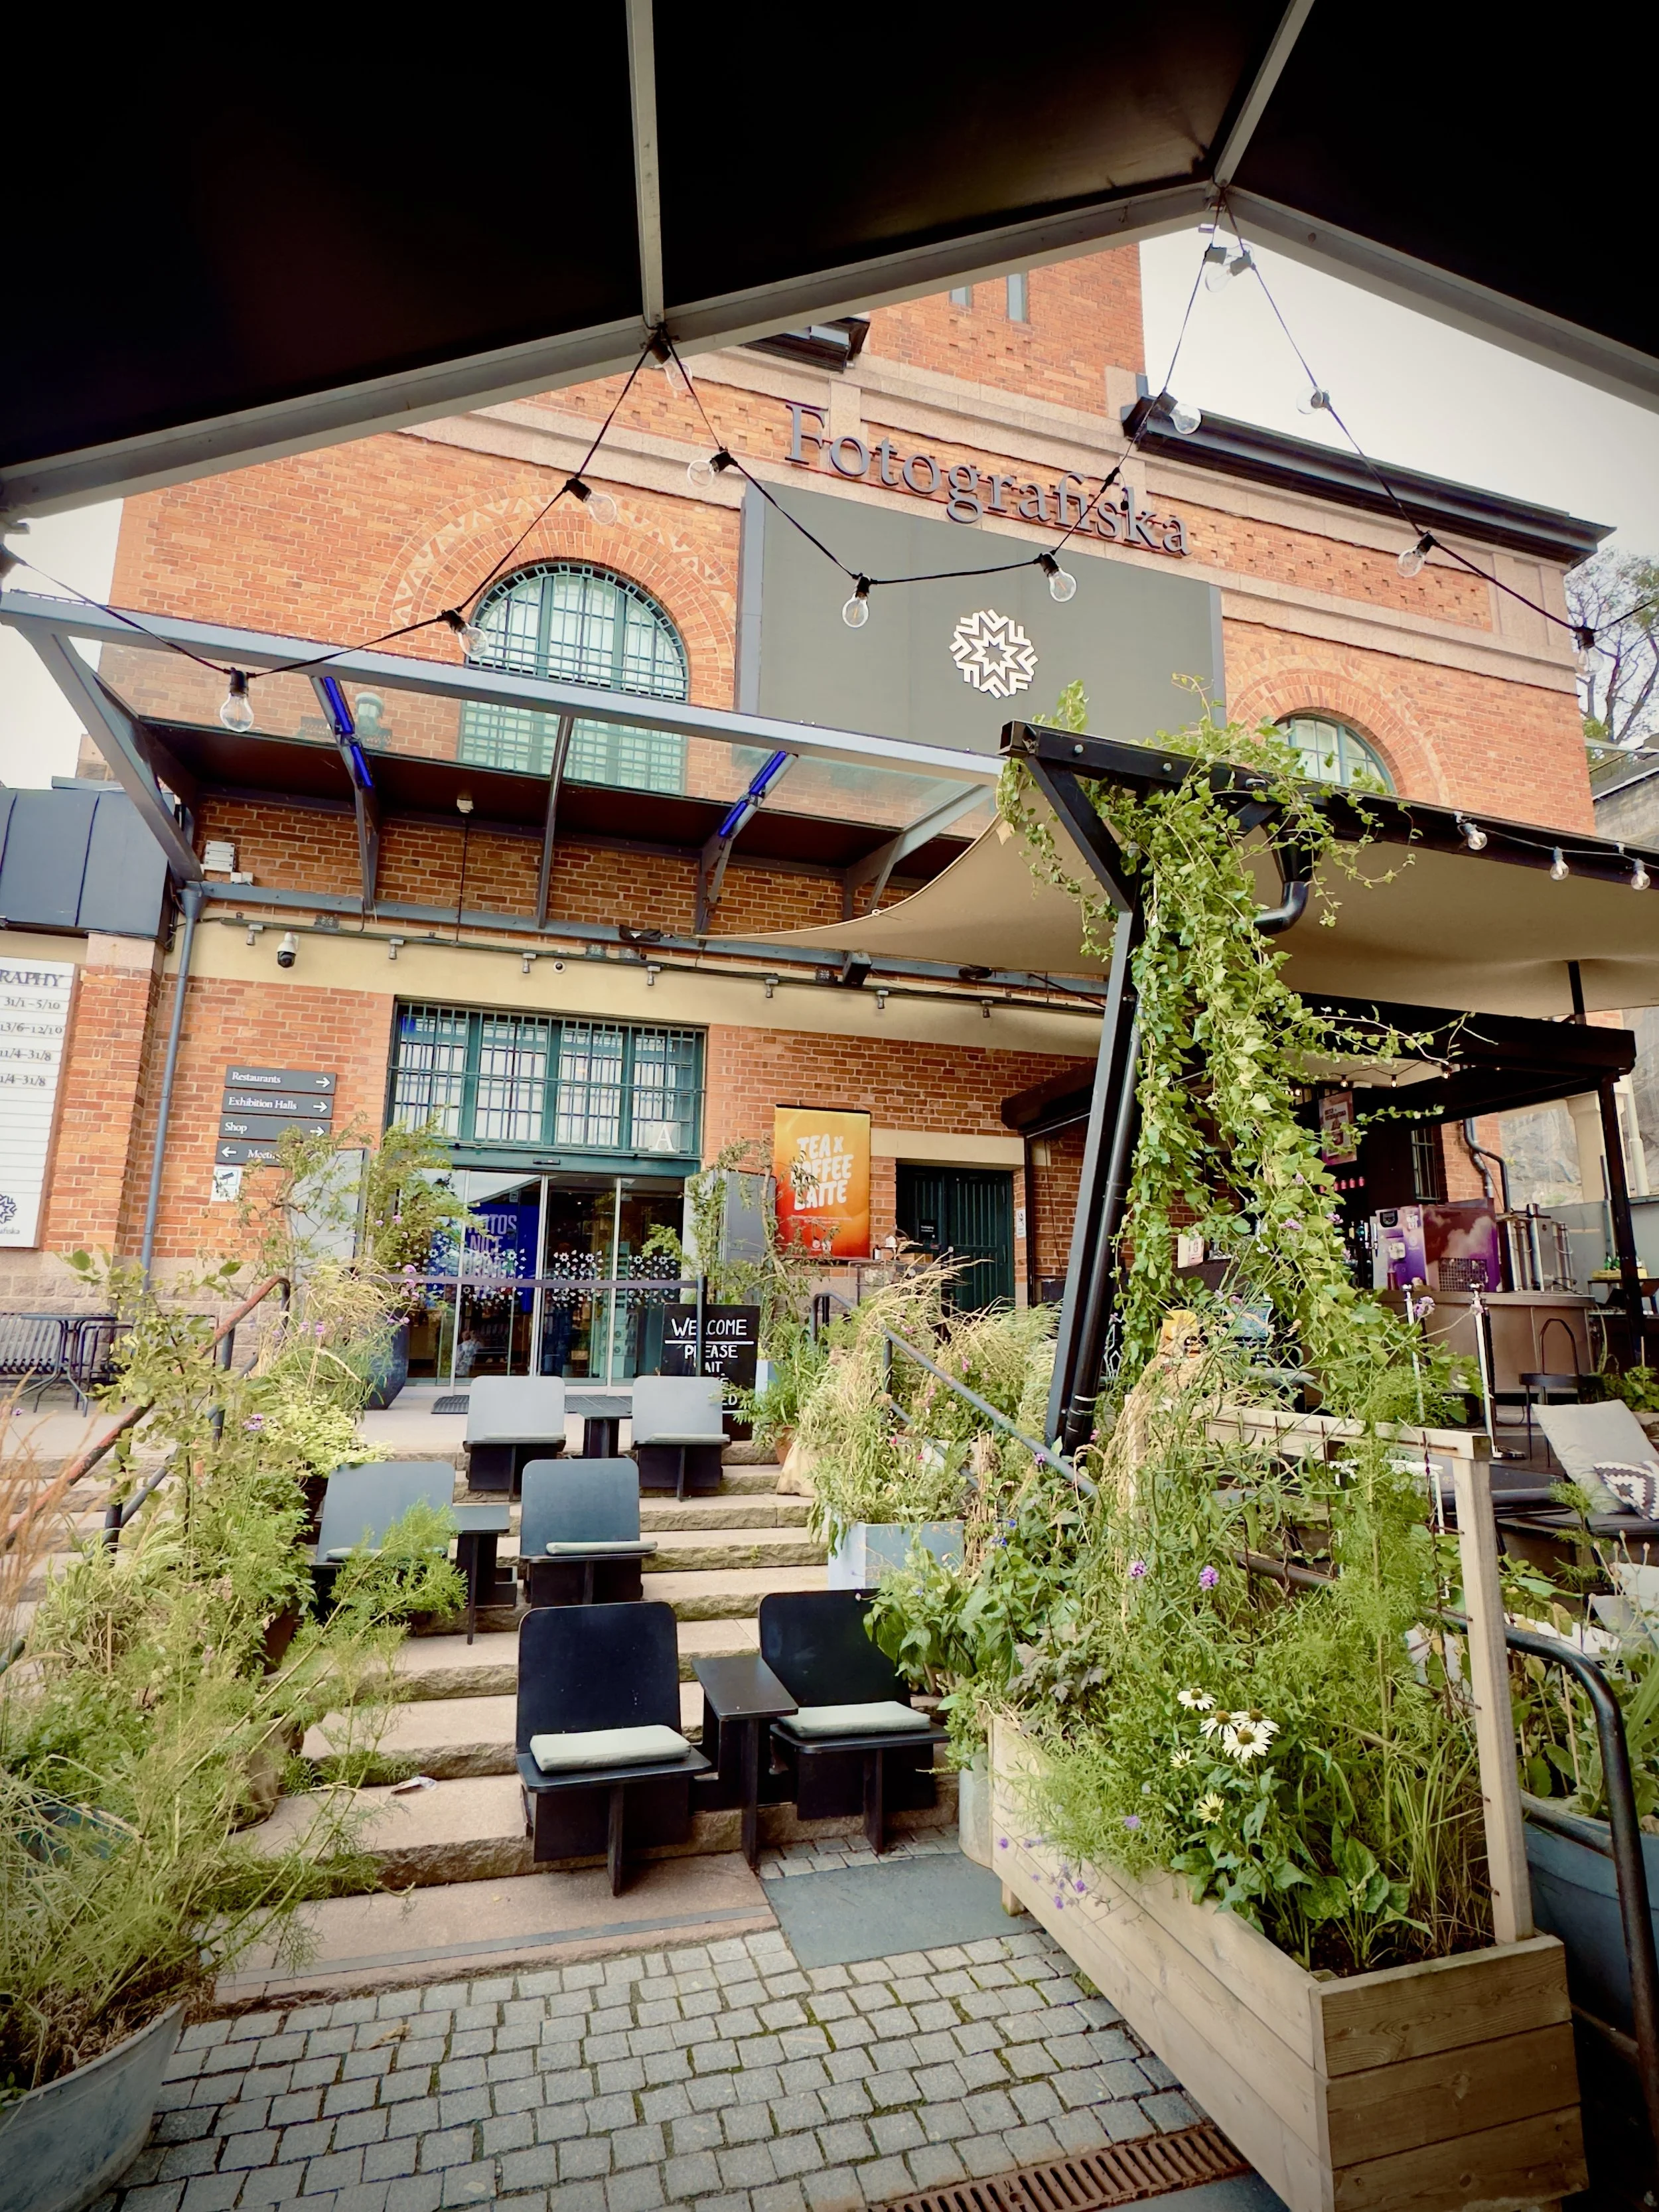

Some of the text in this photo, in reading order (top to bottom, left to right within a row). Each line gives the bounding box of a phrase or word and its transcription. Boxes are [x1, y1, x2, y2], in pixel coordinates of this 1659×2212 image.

[784, 402, 1192, 557] Fotografiska
[232, 1071, 281, 1084] Restaurants
[228, 1096, 297, 1110] Exhibition Halls
[225, 1121, 248, 1134] Shop
[650, 1122, 676, 1152] A
[796, 1133, 831, 1160] TEA
[794, 1179, 848, 1211] LATTE
[671, 1317, 747, 1337] WECOME
